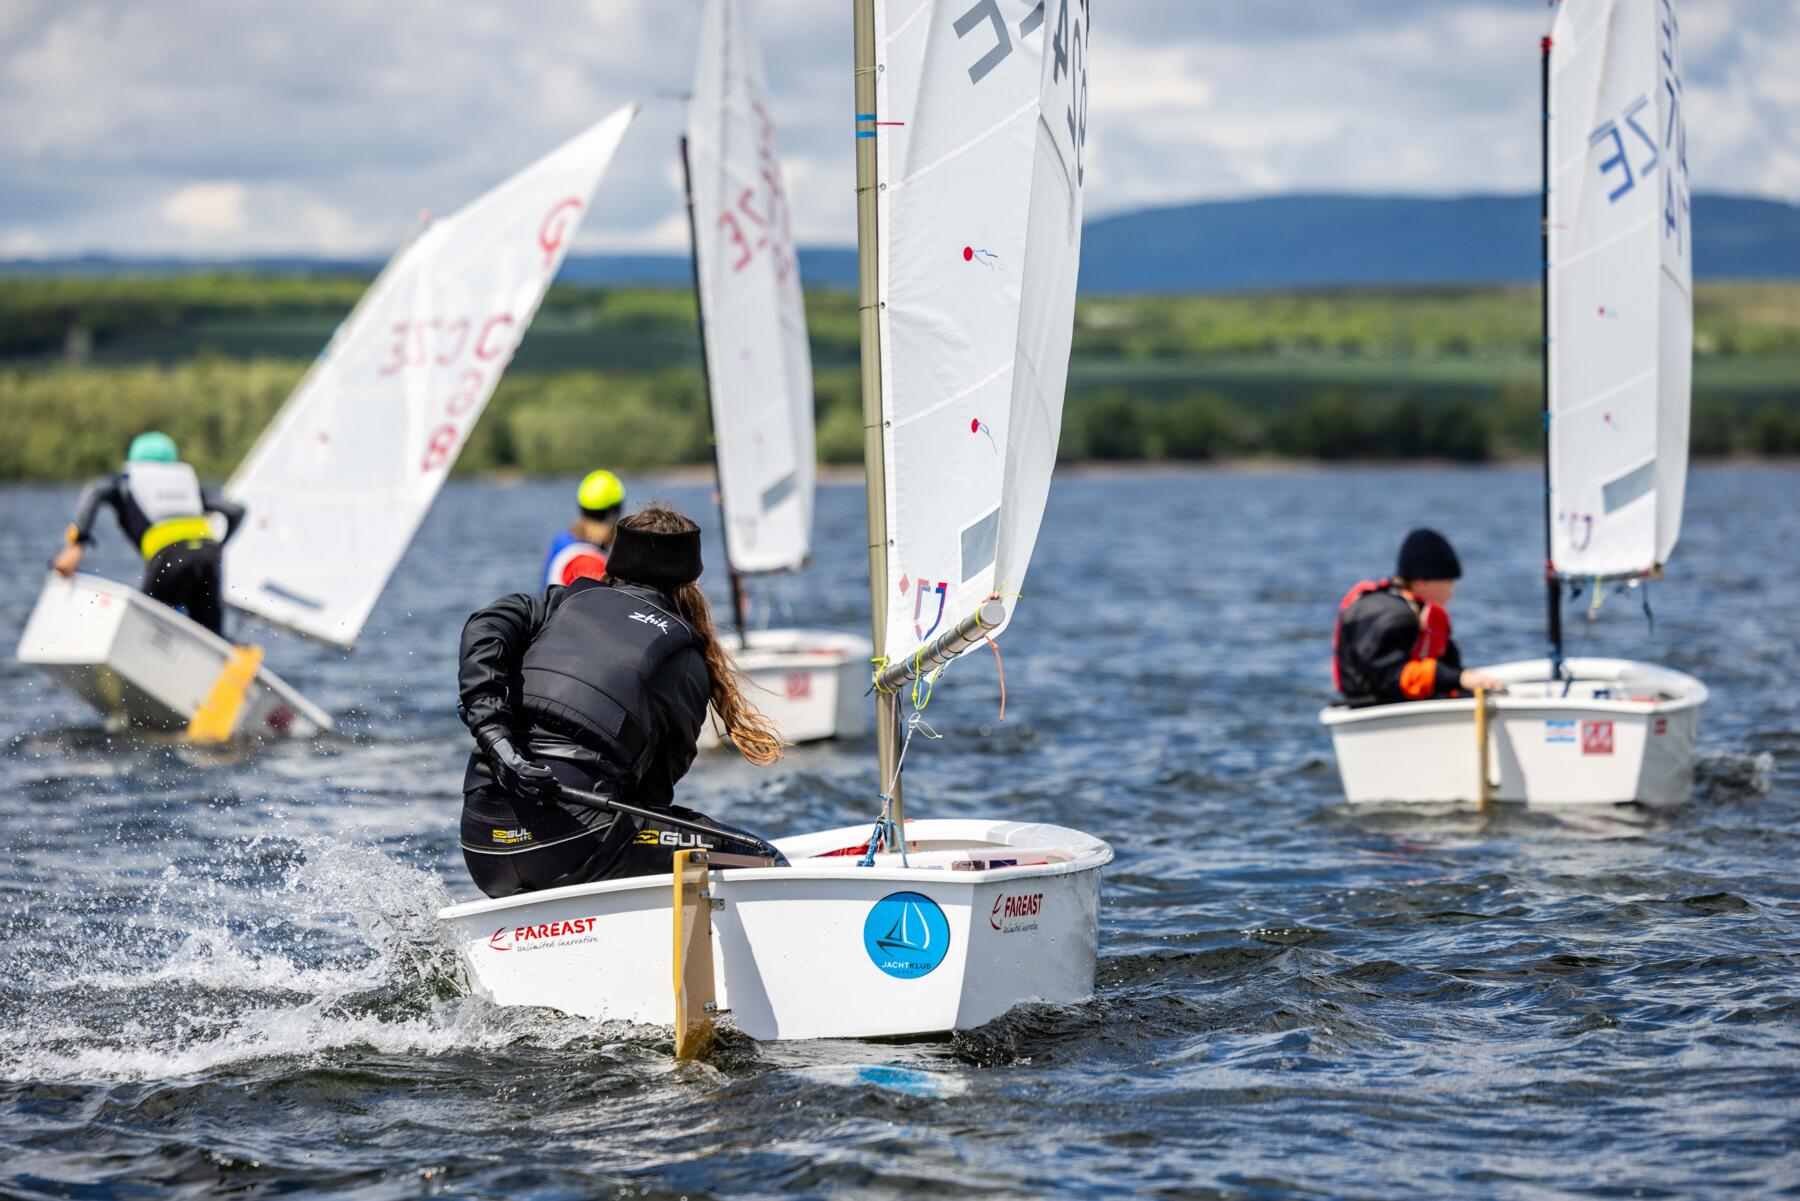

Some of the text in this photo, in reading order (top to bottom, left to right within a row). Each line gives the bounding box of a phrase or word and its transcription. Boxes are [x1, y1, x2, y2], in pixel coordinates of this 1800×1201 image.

[507, 828, 531, 838] GUL
[660, 831, 714, 849] GUL
[1004, 893, 1044, 918] FAREAST
[514, 918, 597, 941] FAREAST
[516, 936, 600, 952] unlimited innovation
